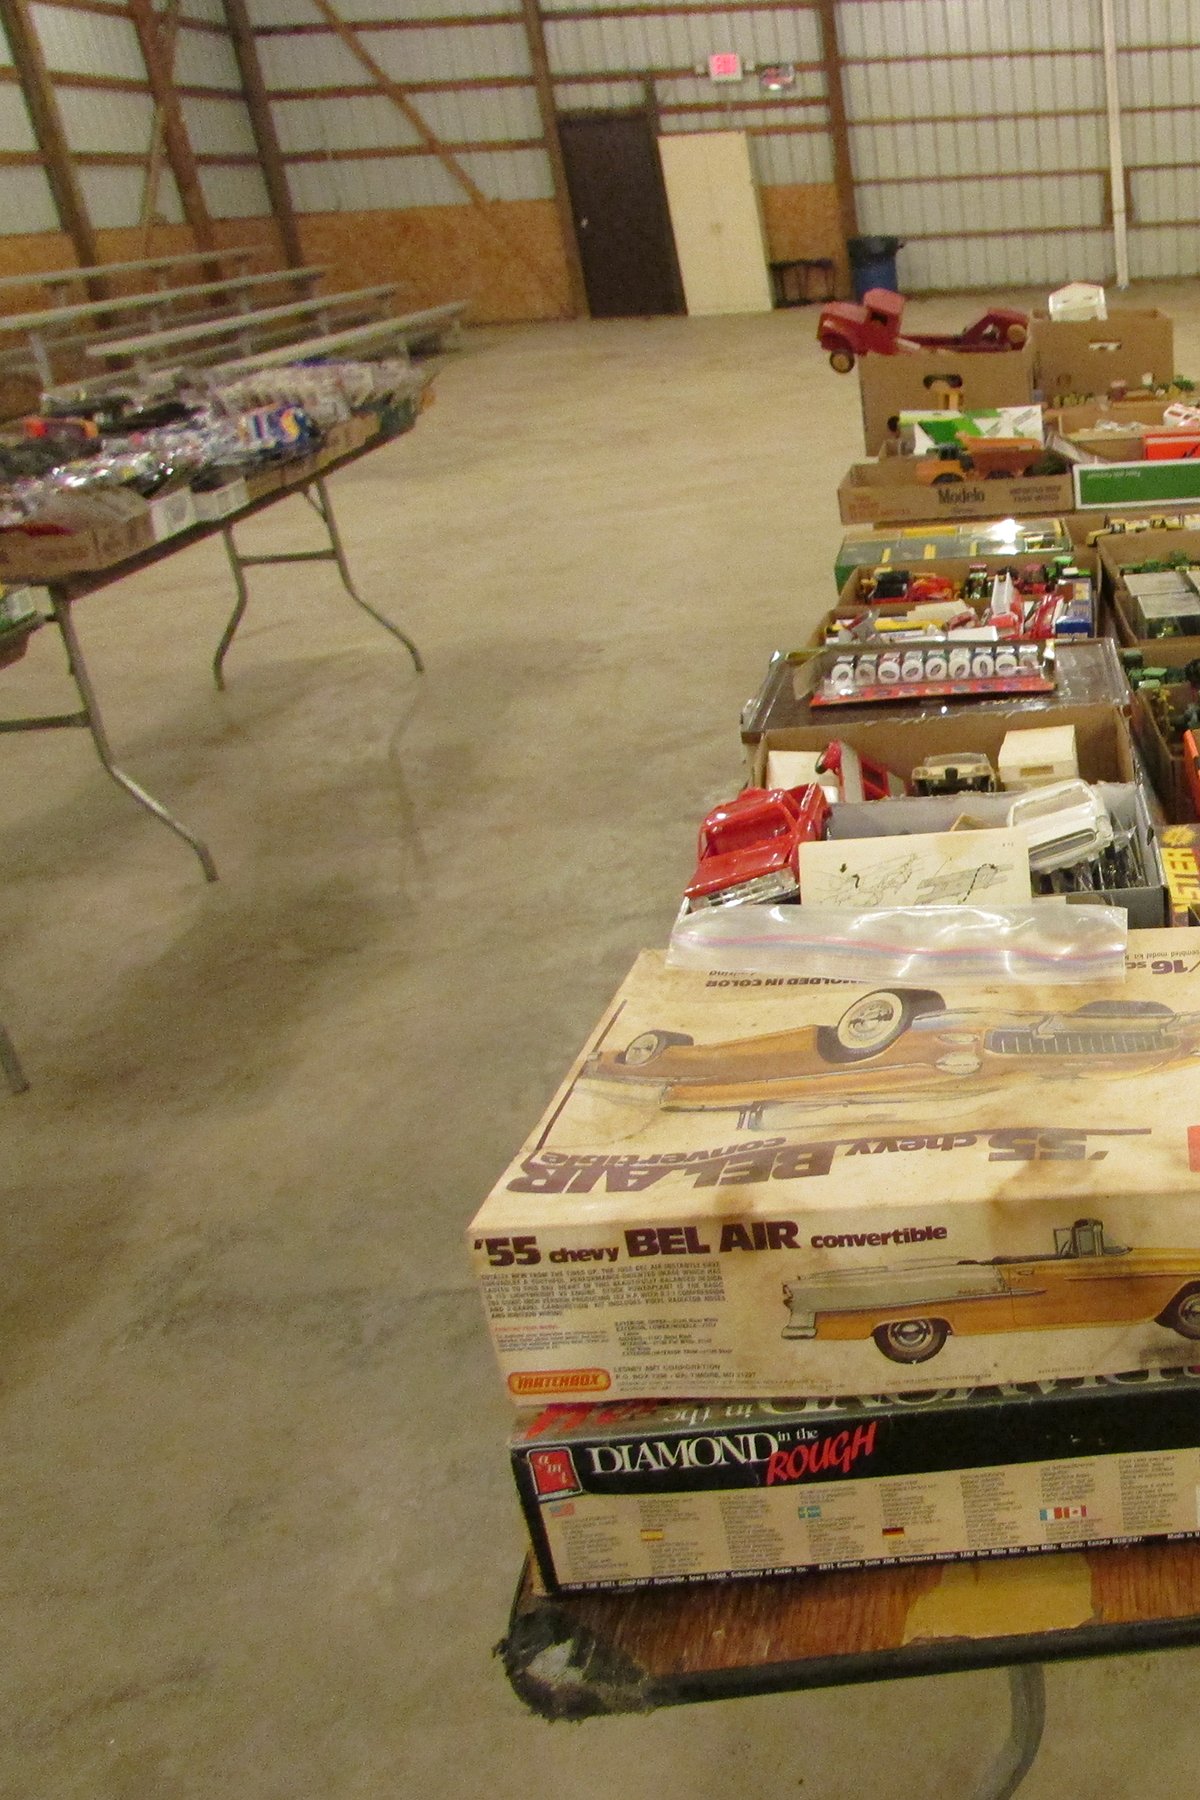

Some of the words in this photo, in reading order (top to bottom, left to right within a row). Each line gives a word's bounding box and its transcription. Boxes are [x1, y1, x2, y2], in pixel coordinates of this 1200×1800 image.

[937, 486, 985, 504] Modelo
[705, 978, 763, 987] COLOR
[765, 978, 784, 987] IN
[541, 1136, 787, 1167] convertible
[846, 1132, 977, 1161] chevy
[989, 1129, 1109, 1165] '55
[506, 1158, 677, 1194] AIR
[692, 1139, 837, 1190] BEL
[473, 1234, 542, 1267] '55
[549, 1246, 620, 1263] chevy
[624, 1225, 711, 1258] BEL
[719, 1220, 801, 1253] AIR
[810, 1225, 948, 1249] convertible
[517, 1372, 601, 1391] MATCHBOX
[662, 1407, 712, 1426] the
[726, 1405, 754, 1418] in
[777, 1430, 792, 1443] in
[796, 1428, 820, 1440] the
[585, 1432, 780, 1475] DIAMOND
[766, 1420, 878, 1487] ROUGH
[537, 1453, 570, 1486] amt
[1167, 1532, 1185, 1540] Made
